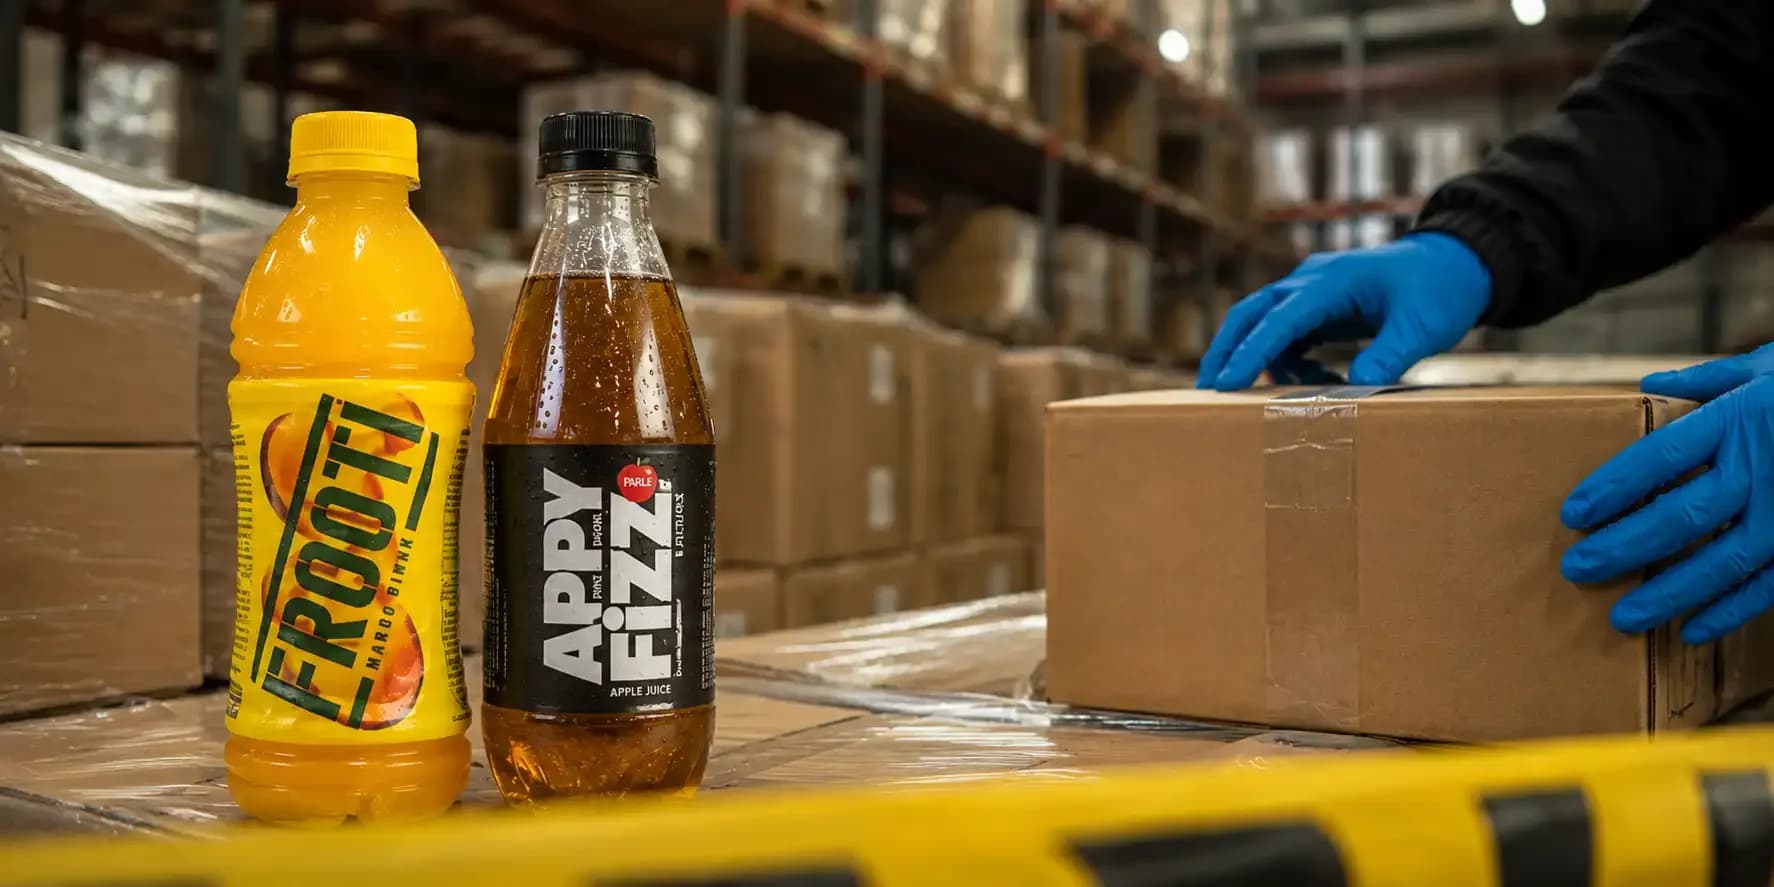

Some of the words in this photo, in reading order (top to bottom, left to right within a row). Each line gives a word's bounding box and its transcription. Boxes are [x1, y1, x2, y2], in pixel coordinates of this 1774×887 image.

[624, 477, 653, 487] PARLE
[262, 400, 425, 721] FROOTI
[543, 467, 602, 685] APPY
[610, 686, 643, 698] APPLE
[645, 684, 672, 696] JUICE
